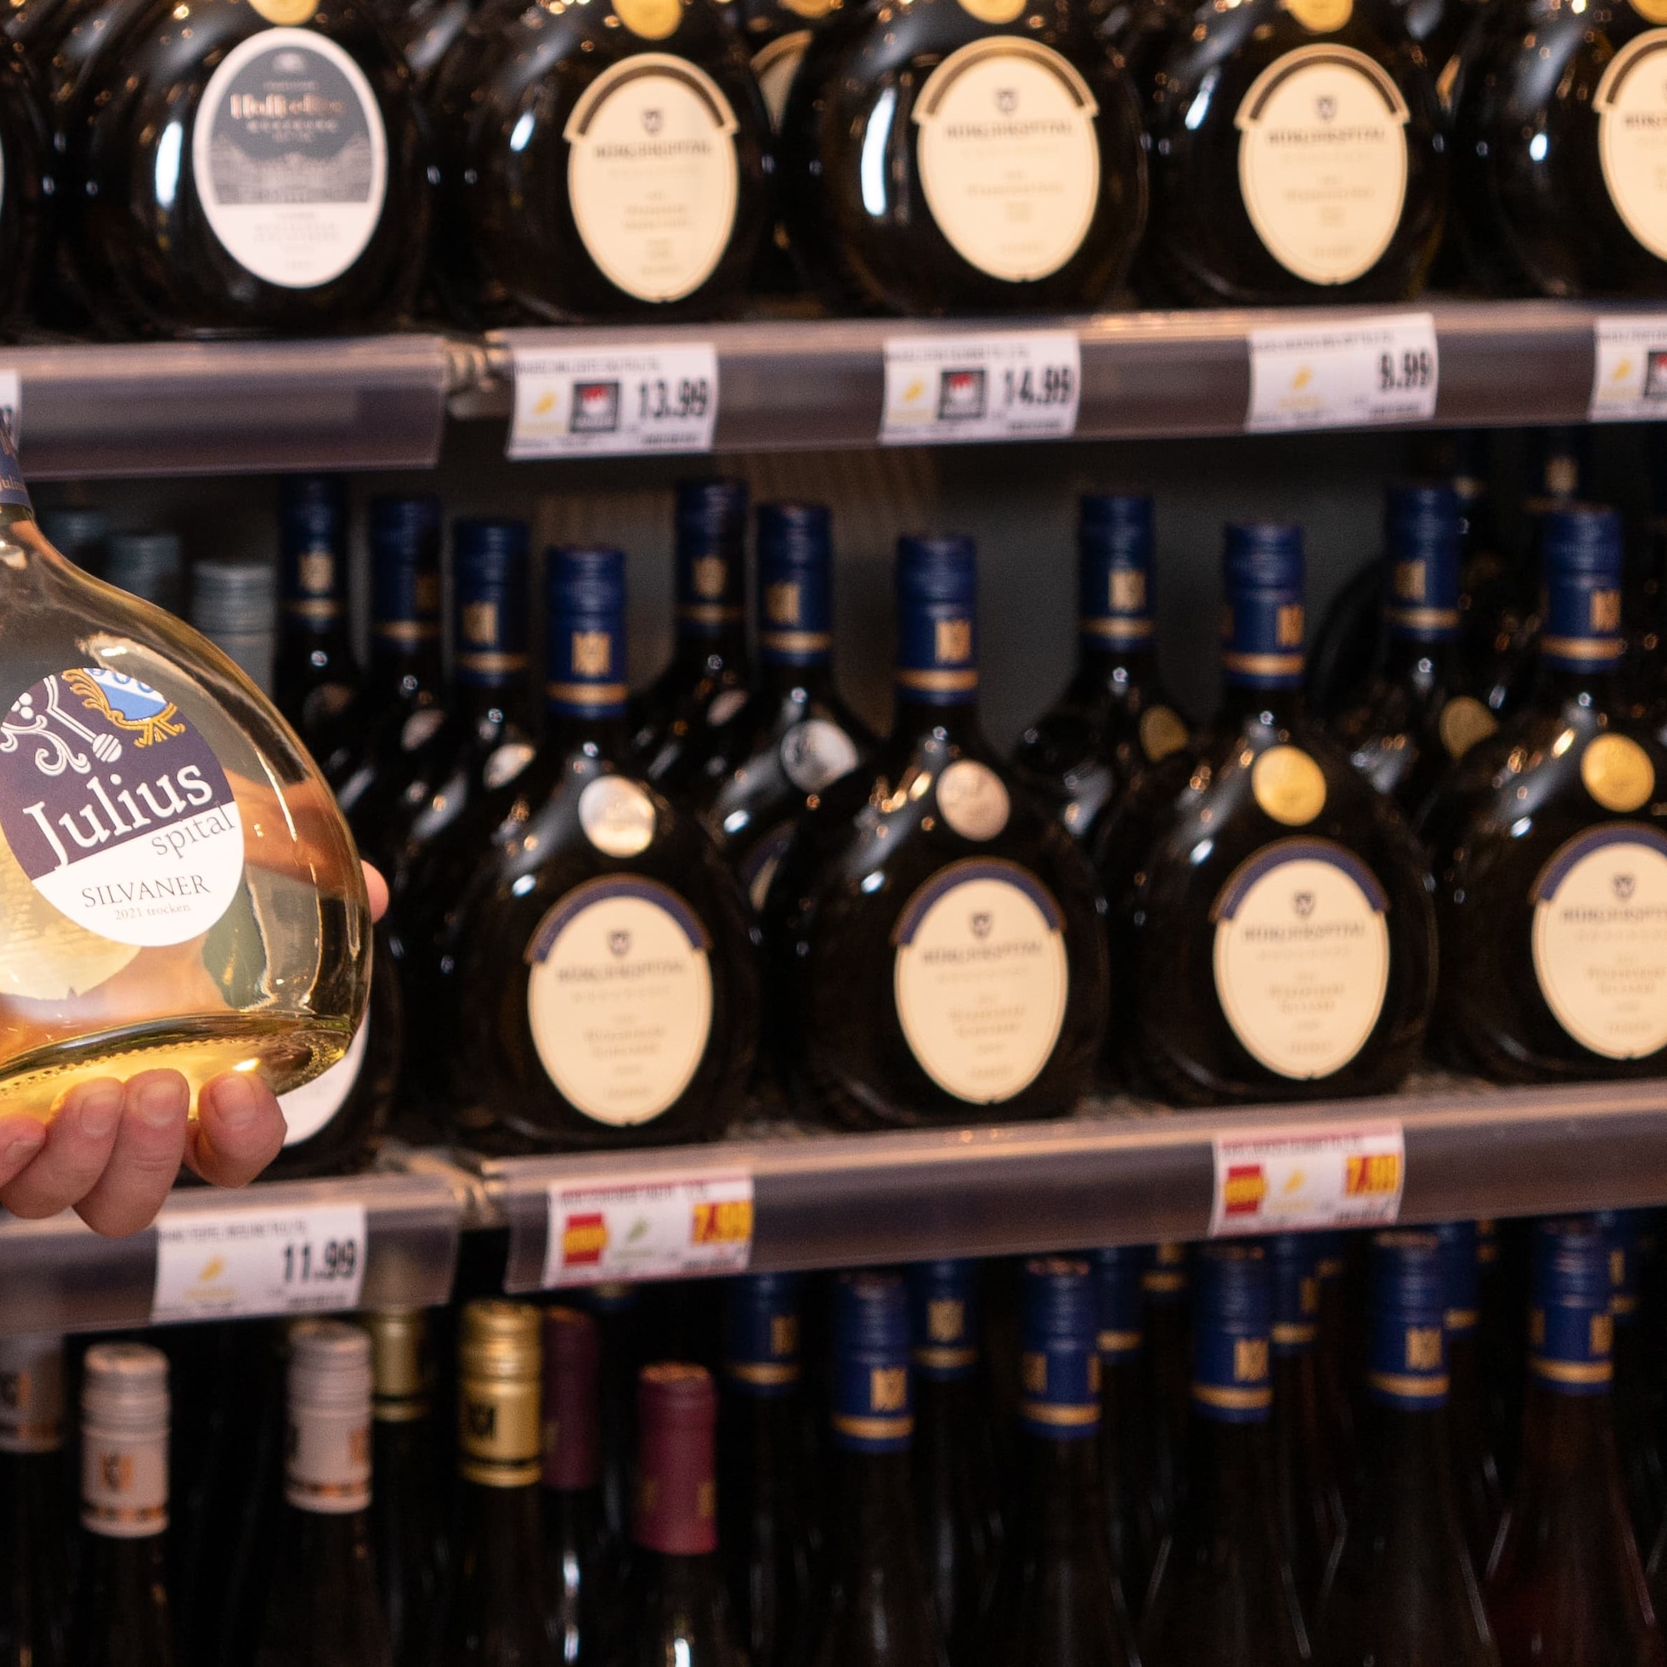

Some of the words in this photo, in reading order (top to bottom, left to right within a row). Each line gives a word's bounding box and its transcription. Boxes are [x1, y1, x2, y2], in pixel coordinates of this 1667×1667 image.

[636, 377, 710, 420] 13.99
[1001, 365, 1073, 409] 14.99
[22, 764, 213, 871] Julius
[151, 800, 237, 860] spital
[81, 873, 211, 909] SILVANER
[115, 908, 144, 921] 2021
[146, 903, 191, 916] trocken
[284, 1239, 356, 1284] 11.99
